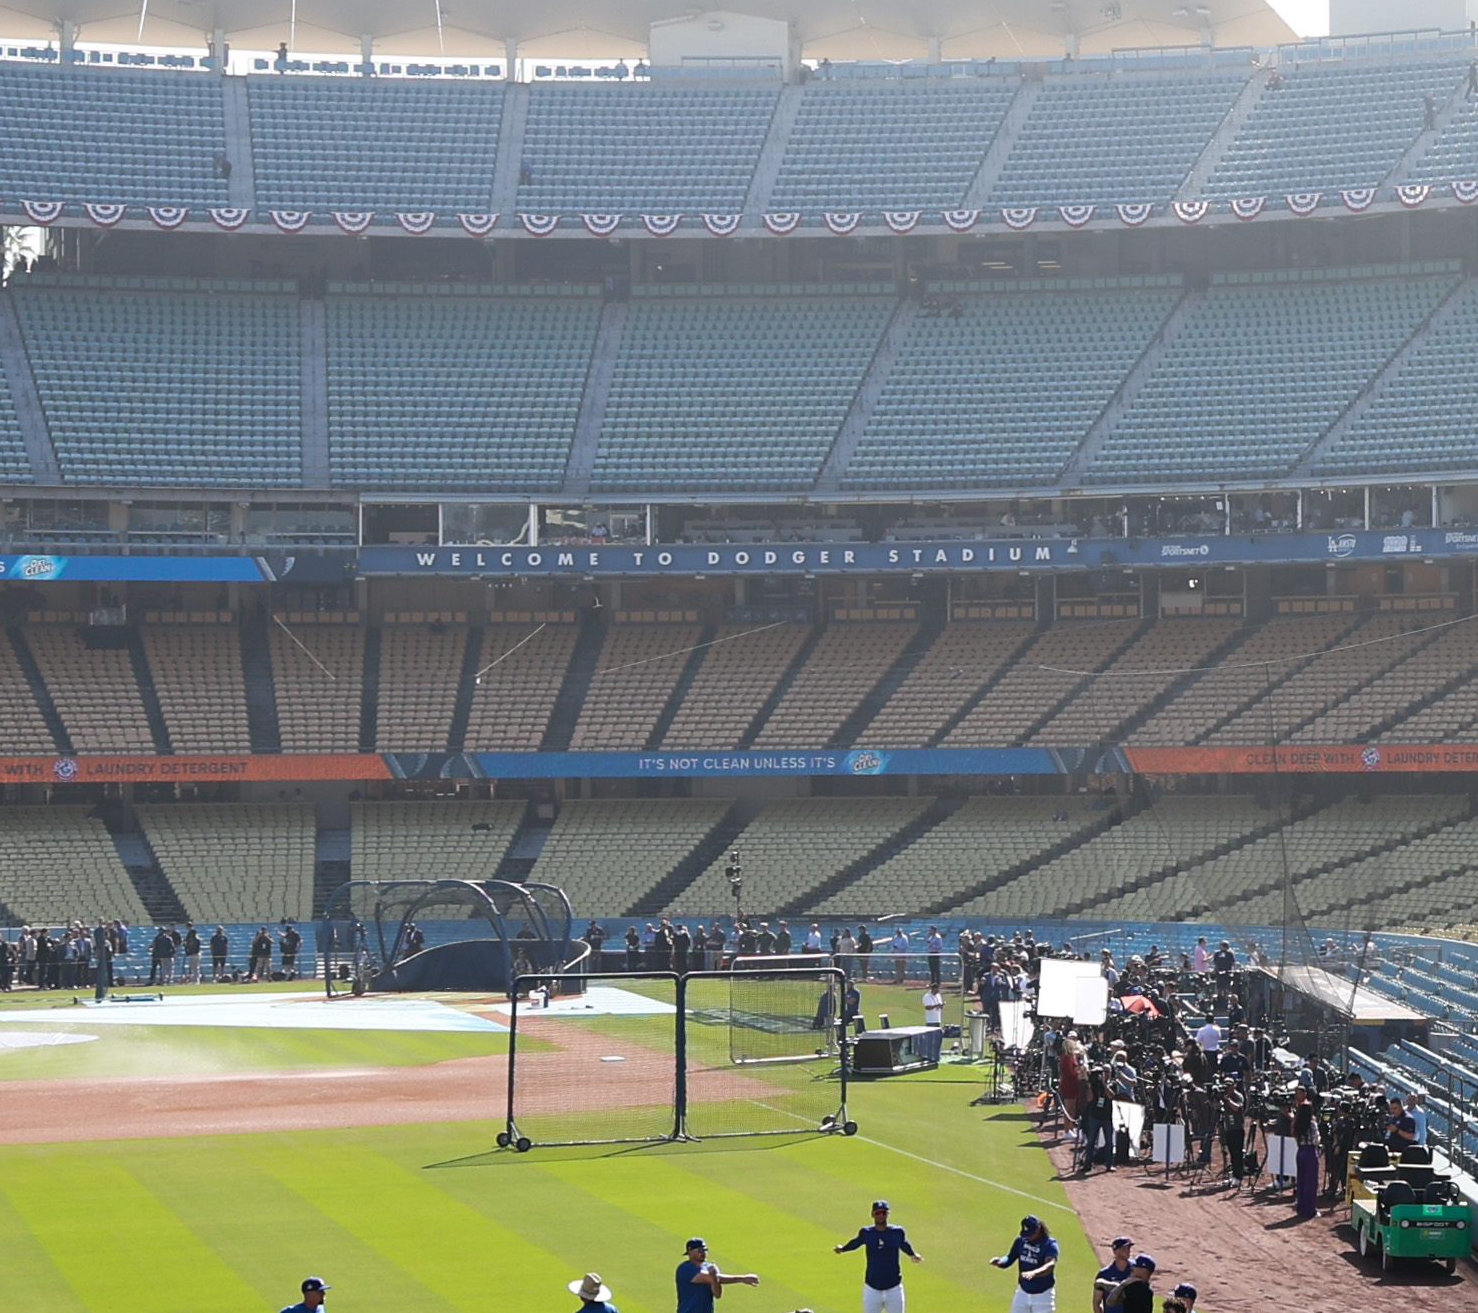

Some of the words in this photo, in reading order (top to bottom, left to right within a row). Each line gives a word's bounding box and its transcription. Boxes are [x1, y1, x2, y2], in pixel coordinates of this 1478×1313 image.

[417, 553, 599, 566] WELCOME
[634, 552, 672, 566] TO
[708, 550, 855, 565] DODGER
[889, 547, 1050, 562] STADIUM
[24, 563, 52, 576] CLEAN
[639, 759, 664, 769] IT'S
[670, 758, 698, 769] NOT
[703, 758, 749, 769] CLEAN
[755, 757, 805, 769] UNLESS
[811, 757, 835, 767] IT'S
[853, 759, 878, 771] CLEAN
[1245, 754, 1286, 765] CLEAN
[1291, 754, 1319, 764] DEEP
[1325, 753, 1354, 764] WITH
[1387, 752, 1440, 763] LAUNDRY
[4, 764, 43, 775] WITH
[86, 763, 156, 774] LAUNDRY
[161, 762, 248, 774] DETERGENT
